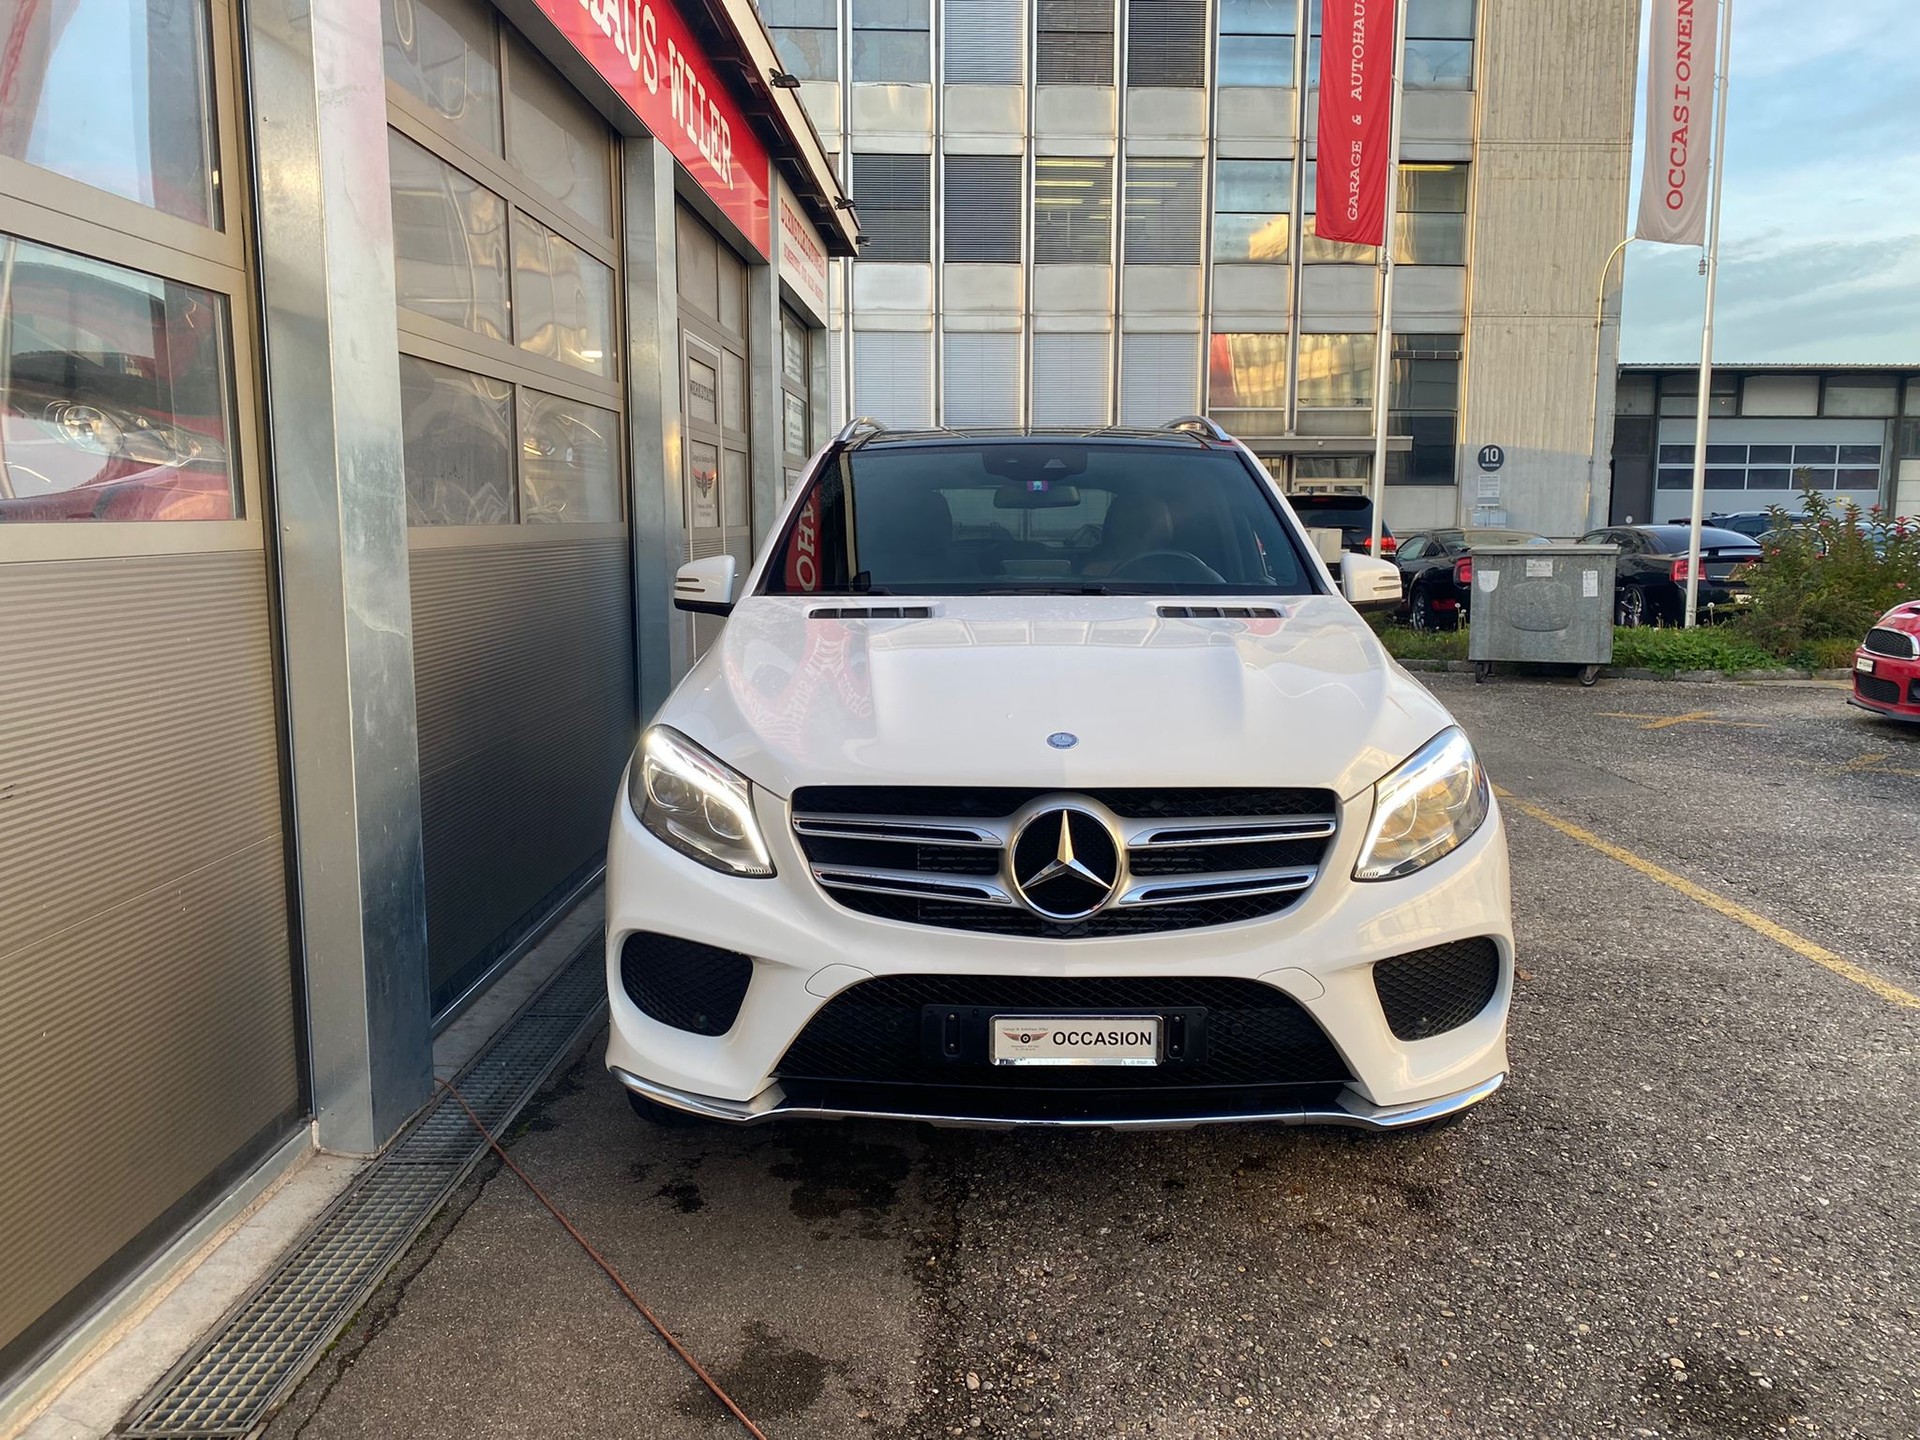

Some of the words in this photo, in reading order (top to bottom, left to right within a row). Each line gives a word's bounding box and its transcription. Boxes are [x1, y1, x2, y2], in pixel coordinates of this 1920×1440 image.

[1351, 0, 1365, 101] AUTOHAU
[667, 38, 733, 190] WILER
[1352, 114, 1362, 125] &
[1666, 0, 1693, 210] OCCASIONEN
[1347, 141, 1362, 220] GARAGE
[1483, 448, 1498, 462] 10
[1052, 1031, 1152, 1046] OCCASION
